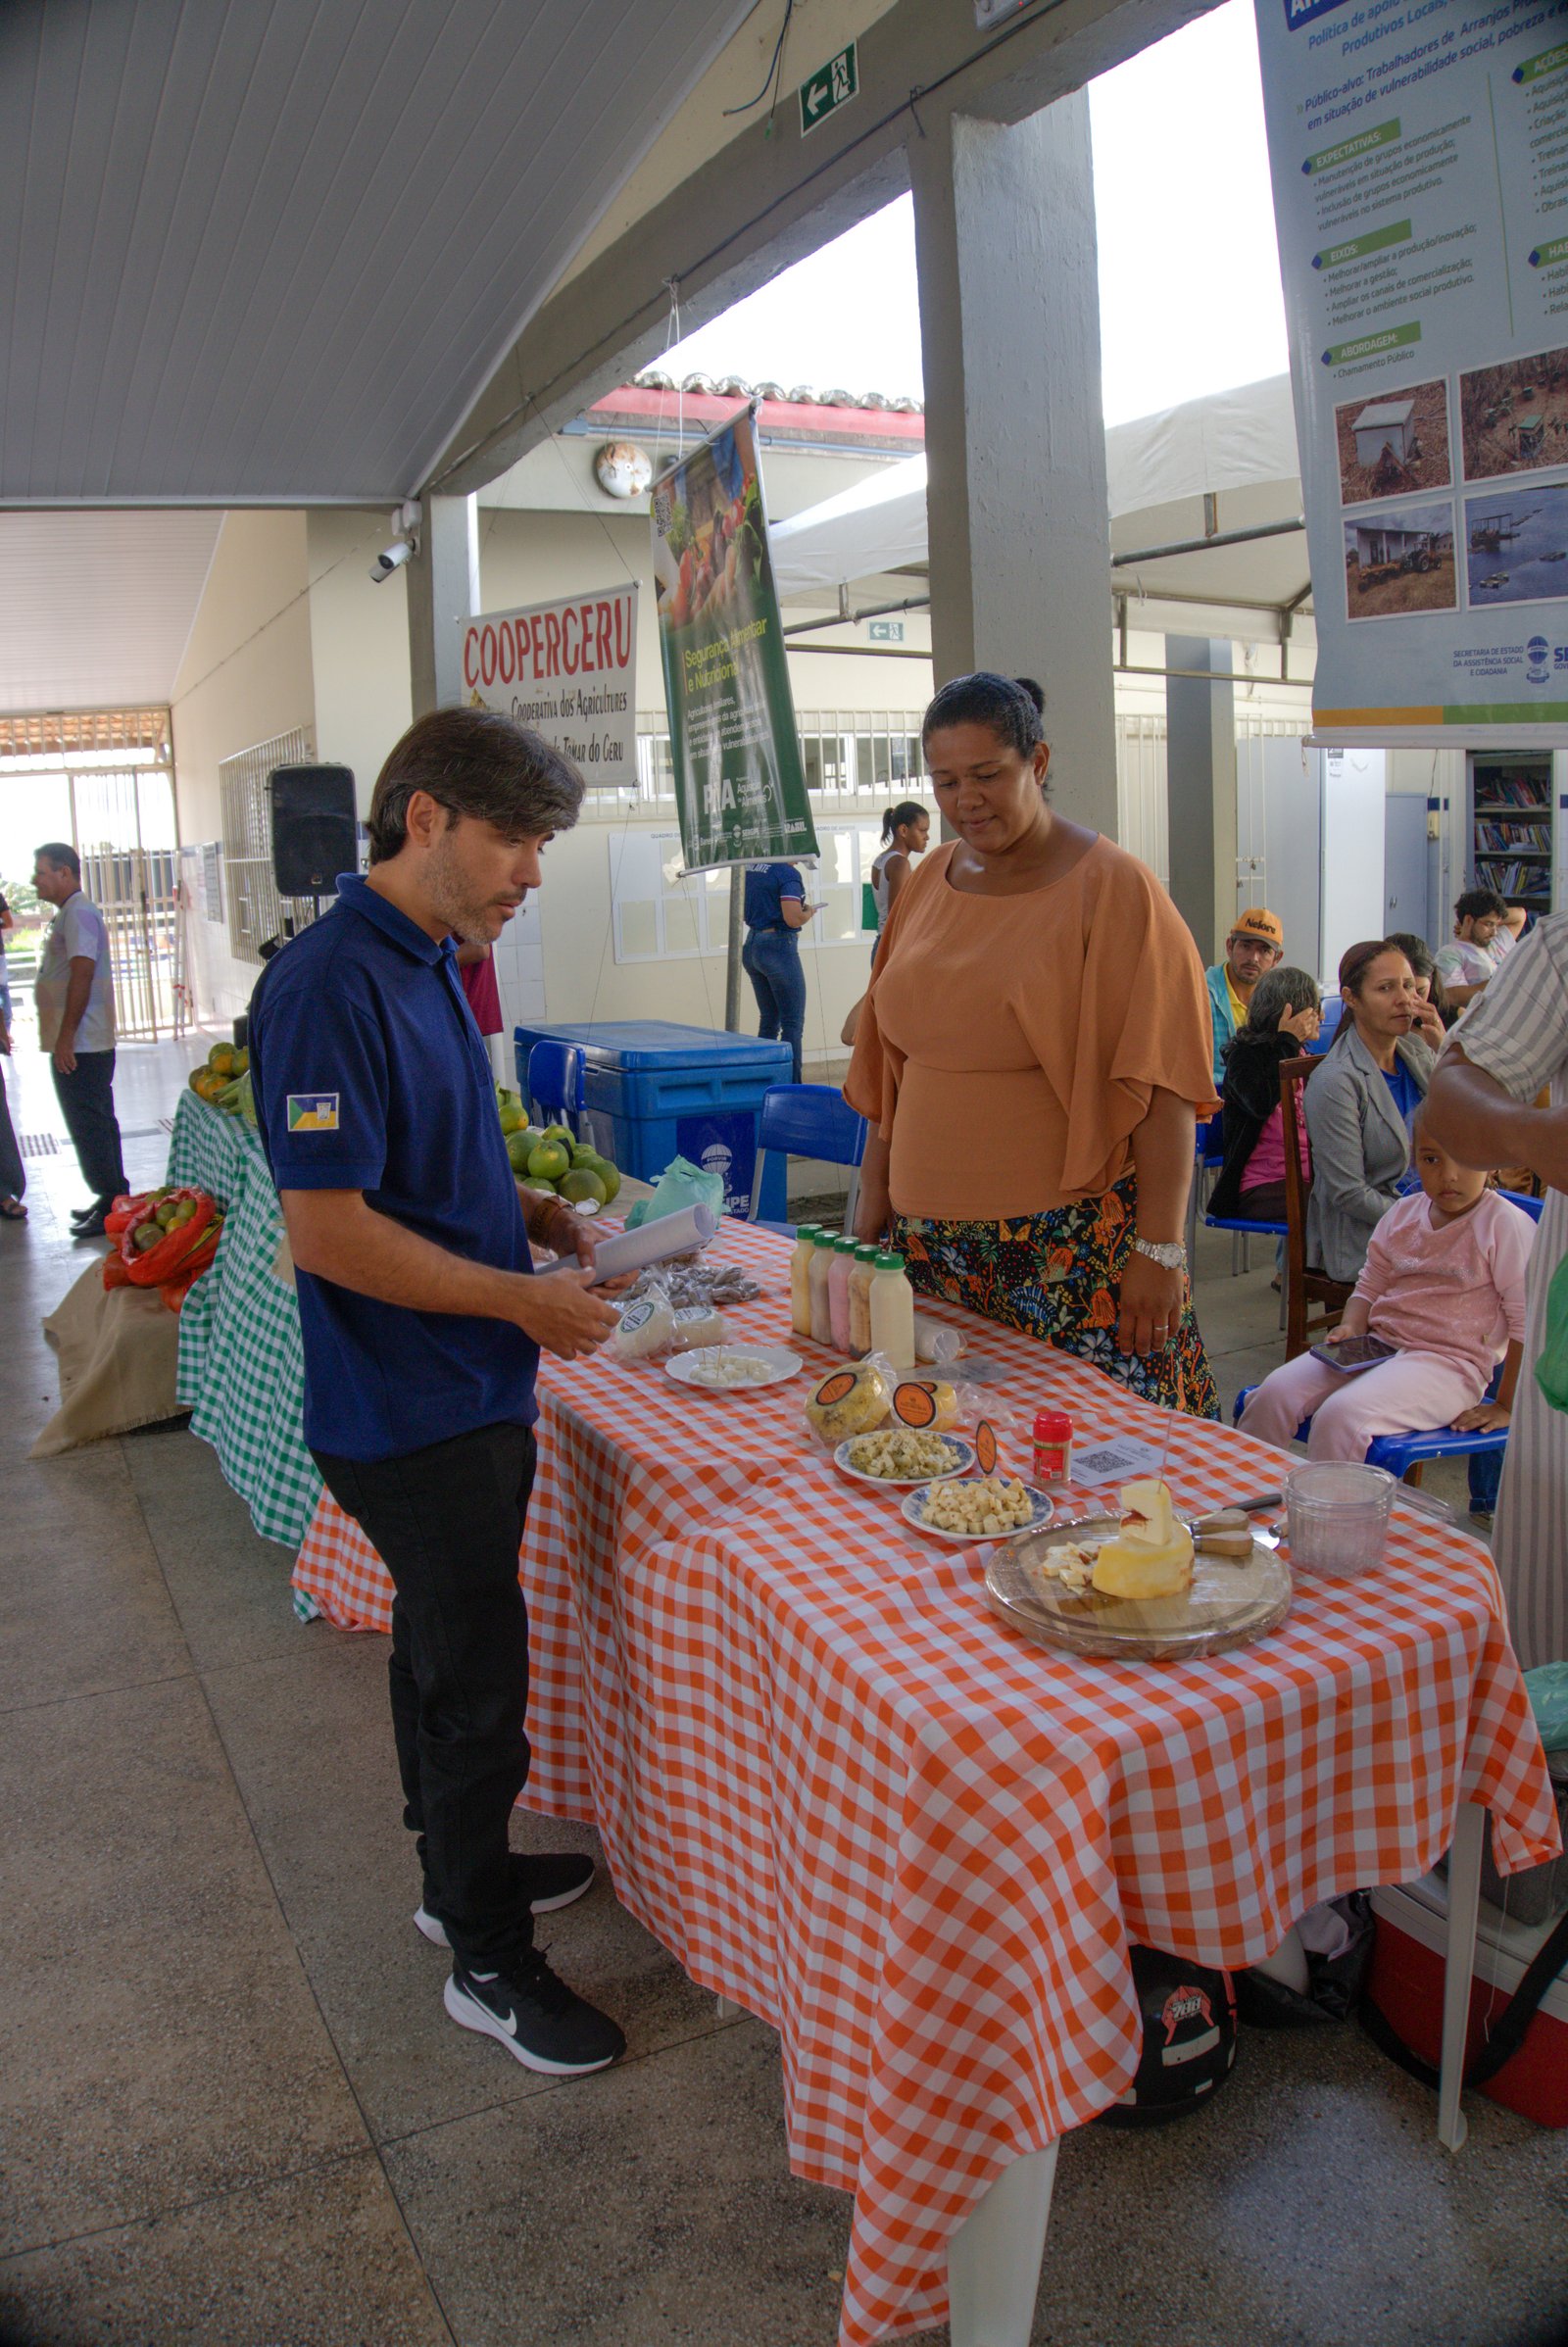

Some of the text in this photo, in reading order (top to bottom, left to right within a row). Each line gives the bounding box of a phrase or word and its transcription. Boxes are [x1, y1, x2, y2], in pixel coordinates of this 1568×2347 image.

[1308, 0, 1399, 50] Política de apoio
[1342, 17, 1404, 57] Produtivos
[1305, 6, 1510, 112] Público-alvo: Trabalhadores de Arranjos
[1307, 117, 1322, 130] em
[1324, 97, 1362, 123] situação
[1365, 89, 1377, 104] de
[1379, 51, 1457, 96] vulnerabilidade
[1460, 32, 1495, 59] social,
[1497, 12, 1545, 46] pobreza
[1316, 131, 1382, 168] EXPECTATIVAS:
[1318, 116, 1471, 187] Manutenção de grupos economicamente
[1315, 181, 1356, 203] vulneráveis
[1357, 175, 1369, 185] em
[1370, 160, 1402, 181] situação
[1404, 155, 1414, 166] de
[1322, 154, 1458, 216] Inclusão de grupos economicamente
[1318, 209, 1359, 231] vulneráveis
[1360, 205, 1370, 215] no
[1372, 193, 1401, 211] sistema
[1328, 253, 1390, 283] Melhorar/ampliar
[1331, 244, 1358, 262] EIXOS:
[1330, 278, 1361, 296] Melhorar
[1331, 295, 1358, 313] Ampliar
[1360, 292, 1369, 302] os
[1371, 283, 1395, 298] canais
[1396, 279, 1406, 290] de
[1333, 308, 1364, 326] Melhorar
[1373, 297, 1407, 314] ambiente
[1409, 287, 1431, 302] social
[1341, 333, 1397, 359] ABORDAGEM:
[1338, 350, 1414, 378] Chamamento Público
[685, 639, 729, 669] Segurança
[1453, 648, 1490, 658] SECRETARIA
[1500, 646, 1524, 655] ESTADO
[1463, 658, 1501, 666] ASSISTÊNCIA
[688, 679, 694, 692] e
[704, 778, 736, 814] PA
[781, 821, 808, 834] RASIL
